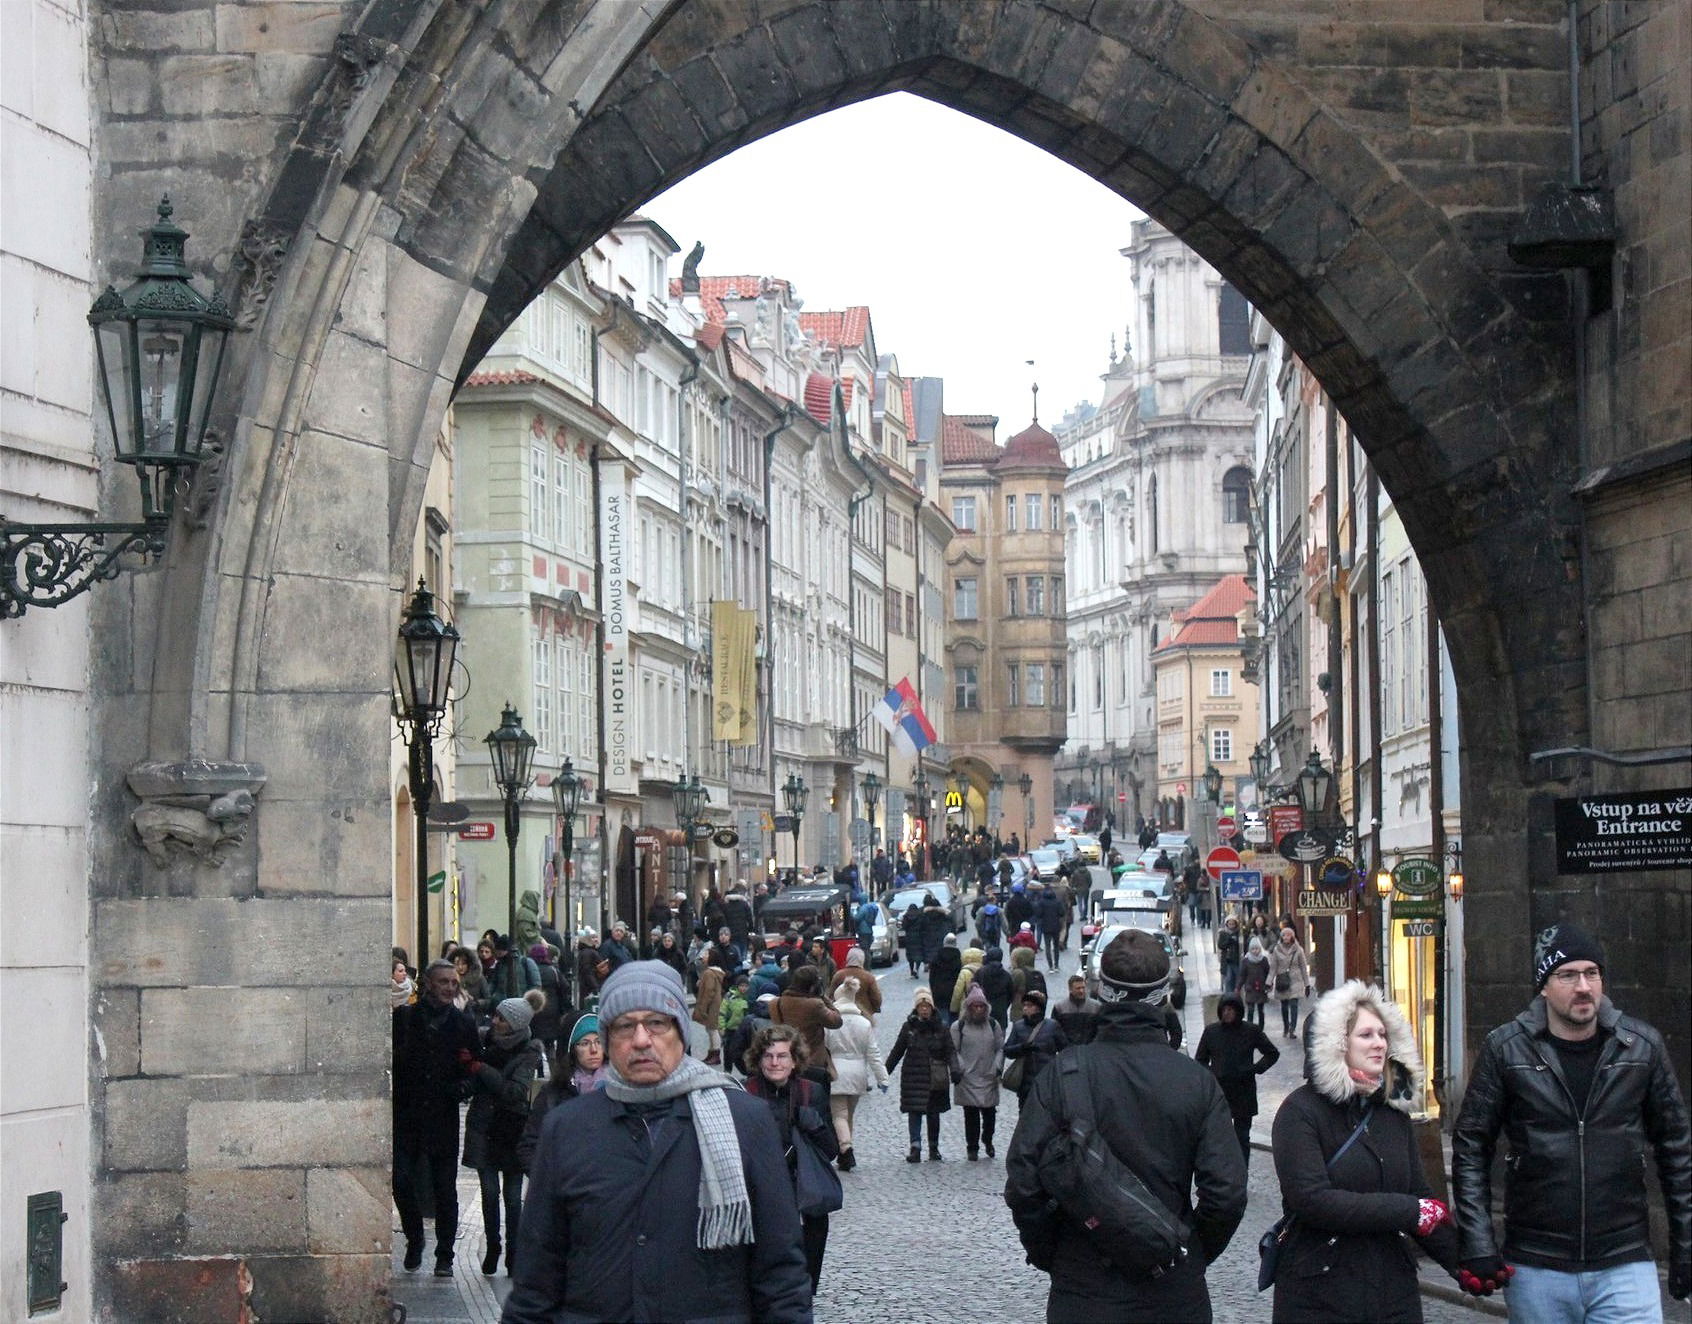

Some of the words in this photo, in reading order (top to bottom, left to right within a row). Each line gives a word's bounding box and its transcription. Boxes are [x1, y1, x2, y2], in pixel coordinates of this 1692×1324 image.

[608, 495, 621, 575] BALTHASAR
[609, 578, 623, 635] DOMUS
[612, 658, 624, 714] HOTEL
[612, 719, 625, 776] DESIGN
[1582, 802, 1634, 821] Vstup
[1637, 802, 1662, 816] na
[1597, 820, 1682, 835] Entrance
[1566, 849, 1619, 858] PANORAMIC
[1624, 846, 1687, 855] OBSERVATION
[1298, 891, 1347, 908] CHANGE
[1409, 923, 1433, 936] WC
